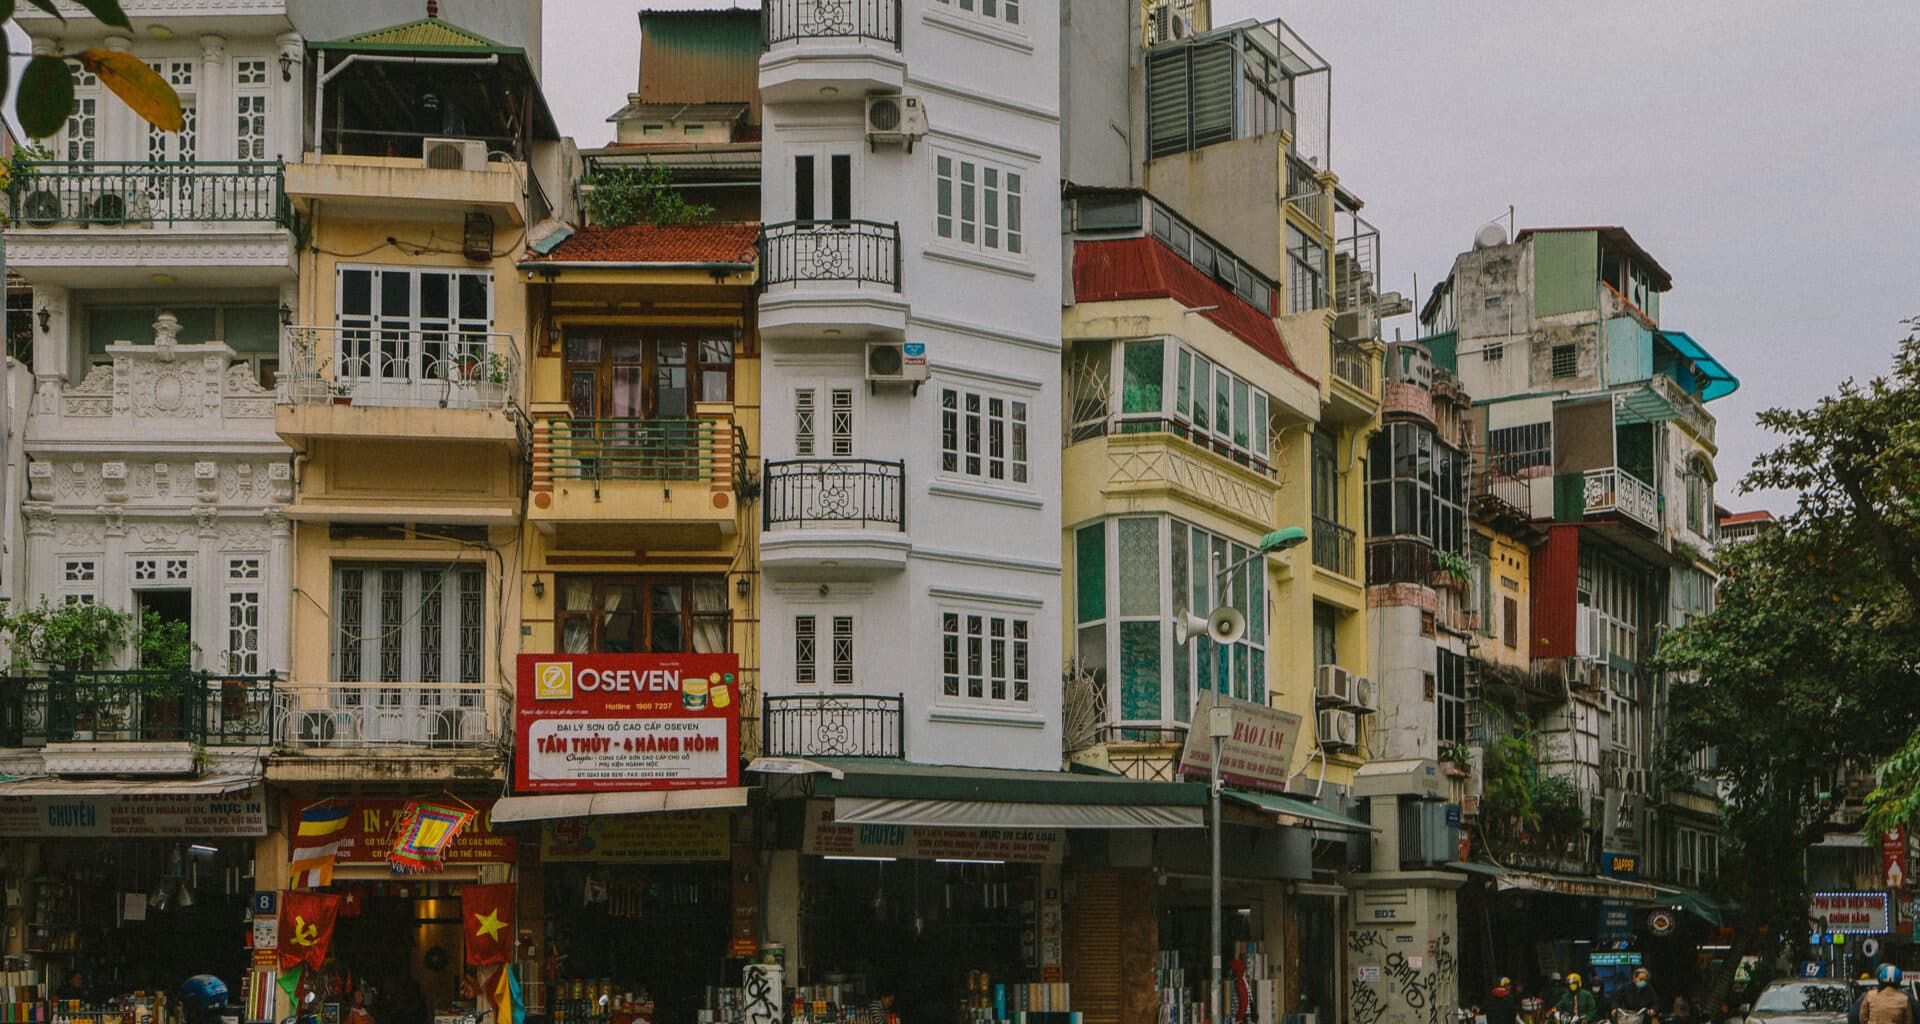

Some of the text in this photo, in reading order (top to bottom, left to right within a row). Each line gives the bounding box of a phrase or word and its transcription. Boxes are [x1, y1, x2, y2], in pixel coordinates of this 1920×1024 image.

[577, 668, 679, 692] OSEVEN
[573, 721, 584, 731] LÝ
[586, 723, 604, 731] SƠN
[607, 721, 621, 731] GỖ
[623, 723, 641, 731] CAO
[645, 721, 661, 731] CẤP
[664, 723, 699, 731] OSEVEN
[623, 737, 633, 752] 4
[635, 733, 679, 752] HÀNG
[684, 733, 719, 752] HÒM
[48, 800, 96, 827] CHUYÊN
[210, 803, 241, 817] MỰC
[246, 803, 260, 814] IN
[362, 809, 381, 833] IN
[1003, 831, 1013, 840] IN
[259, 895, 269, 910] 8
